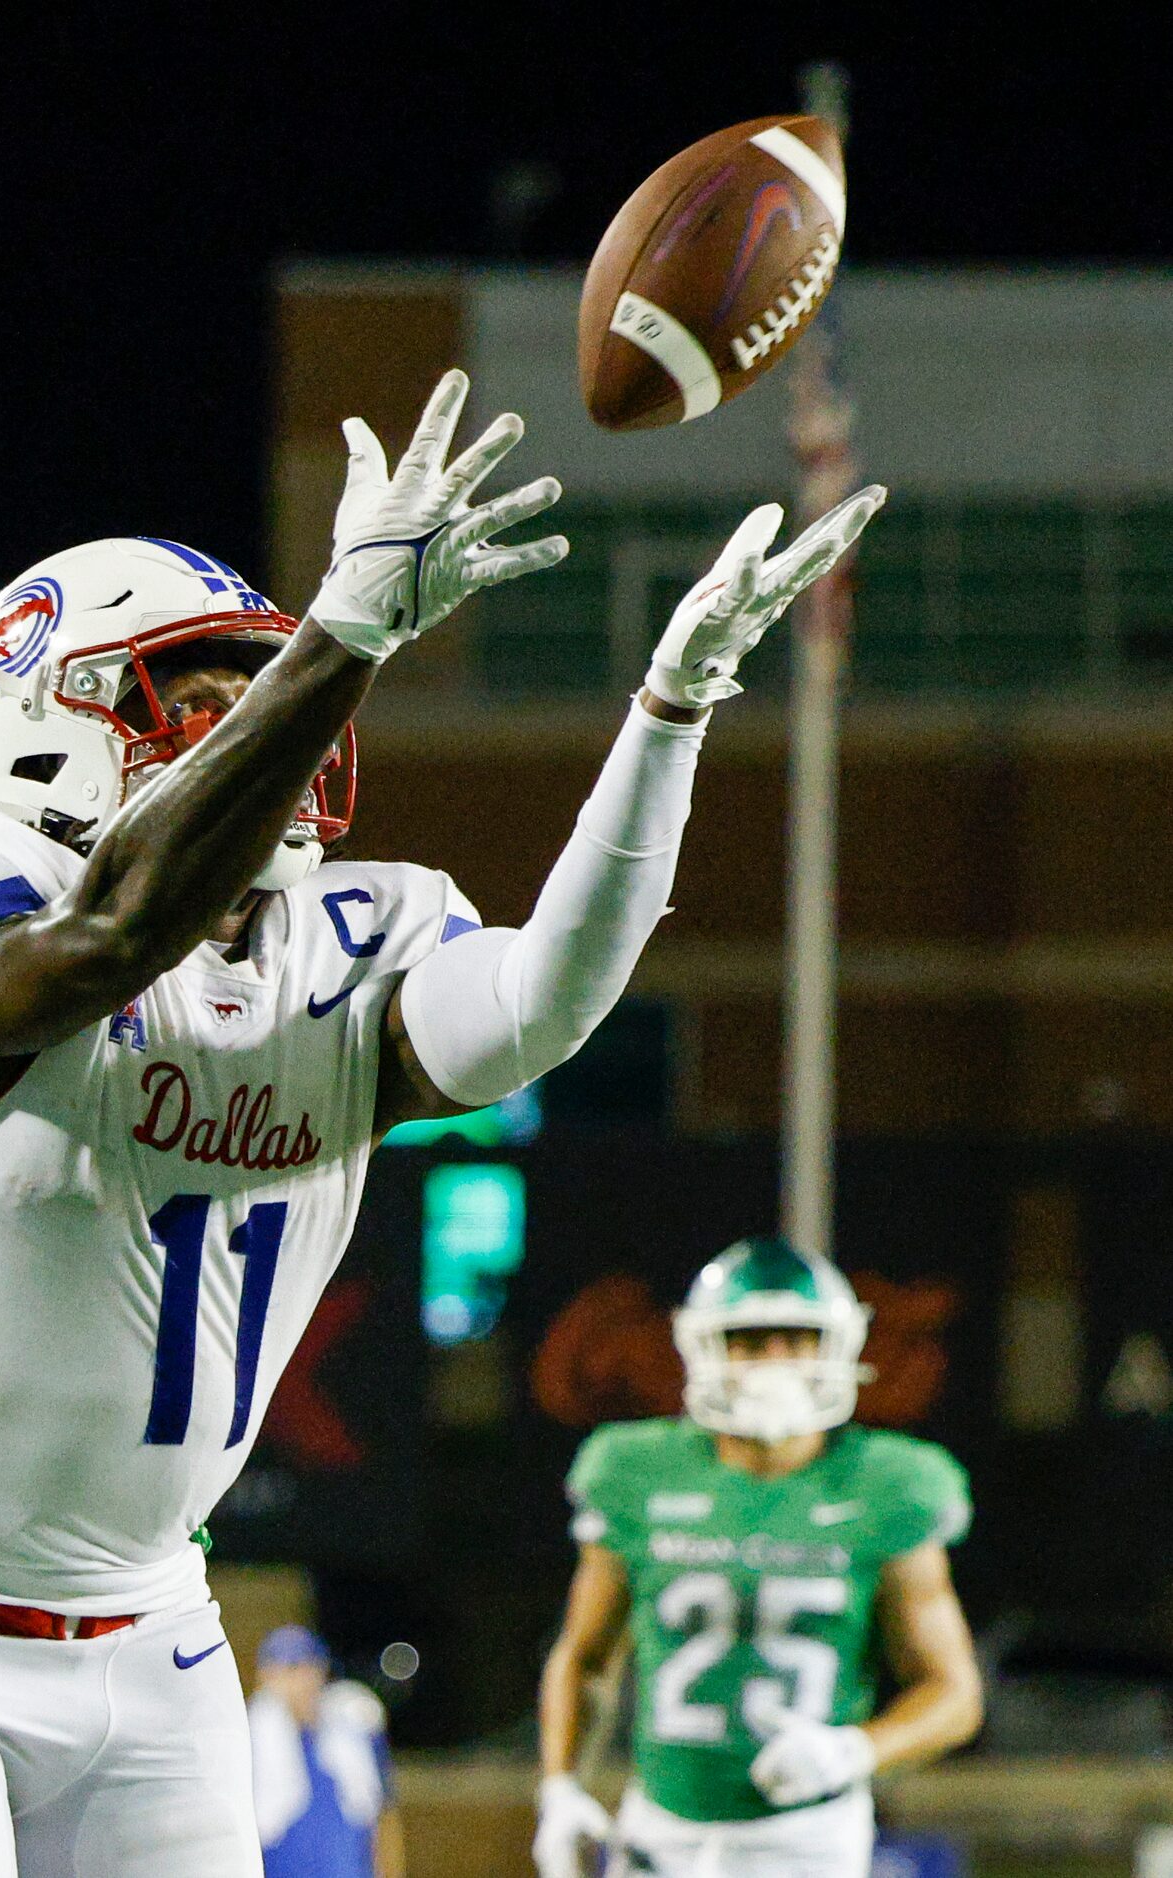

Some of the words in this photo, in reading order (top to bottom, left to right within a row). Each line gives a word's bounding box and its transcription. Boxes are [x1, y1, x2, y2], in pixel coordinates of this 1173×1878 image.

[321, 888, 386, 958] C
[133, 1061, 322, 1171] Dallas
[143, 1193, 289, 1451] 11
[655, 1572, 848, 1745] 25
